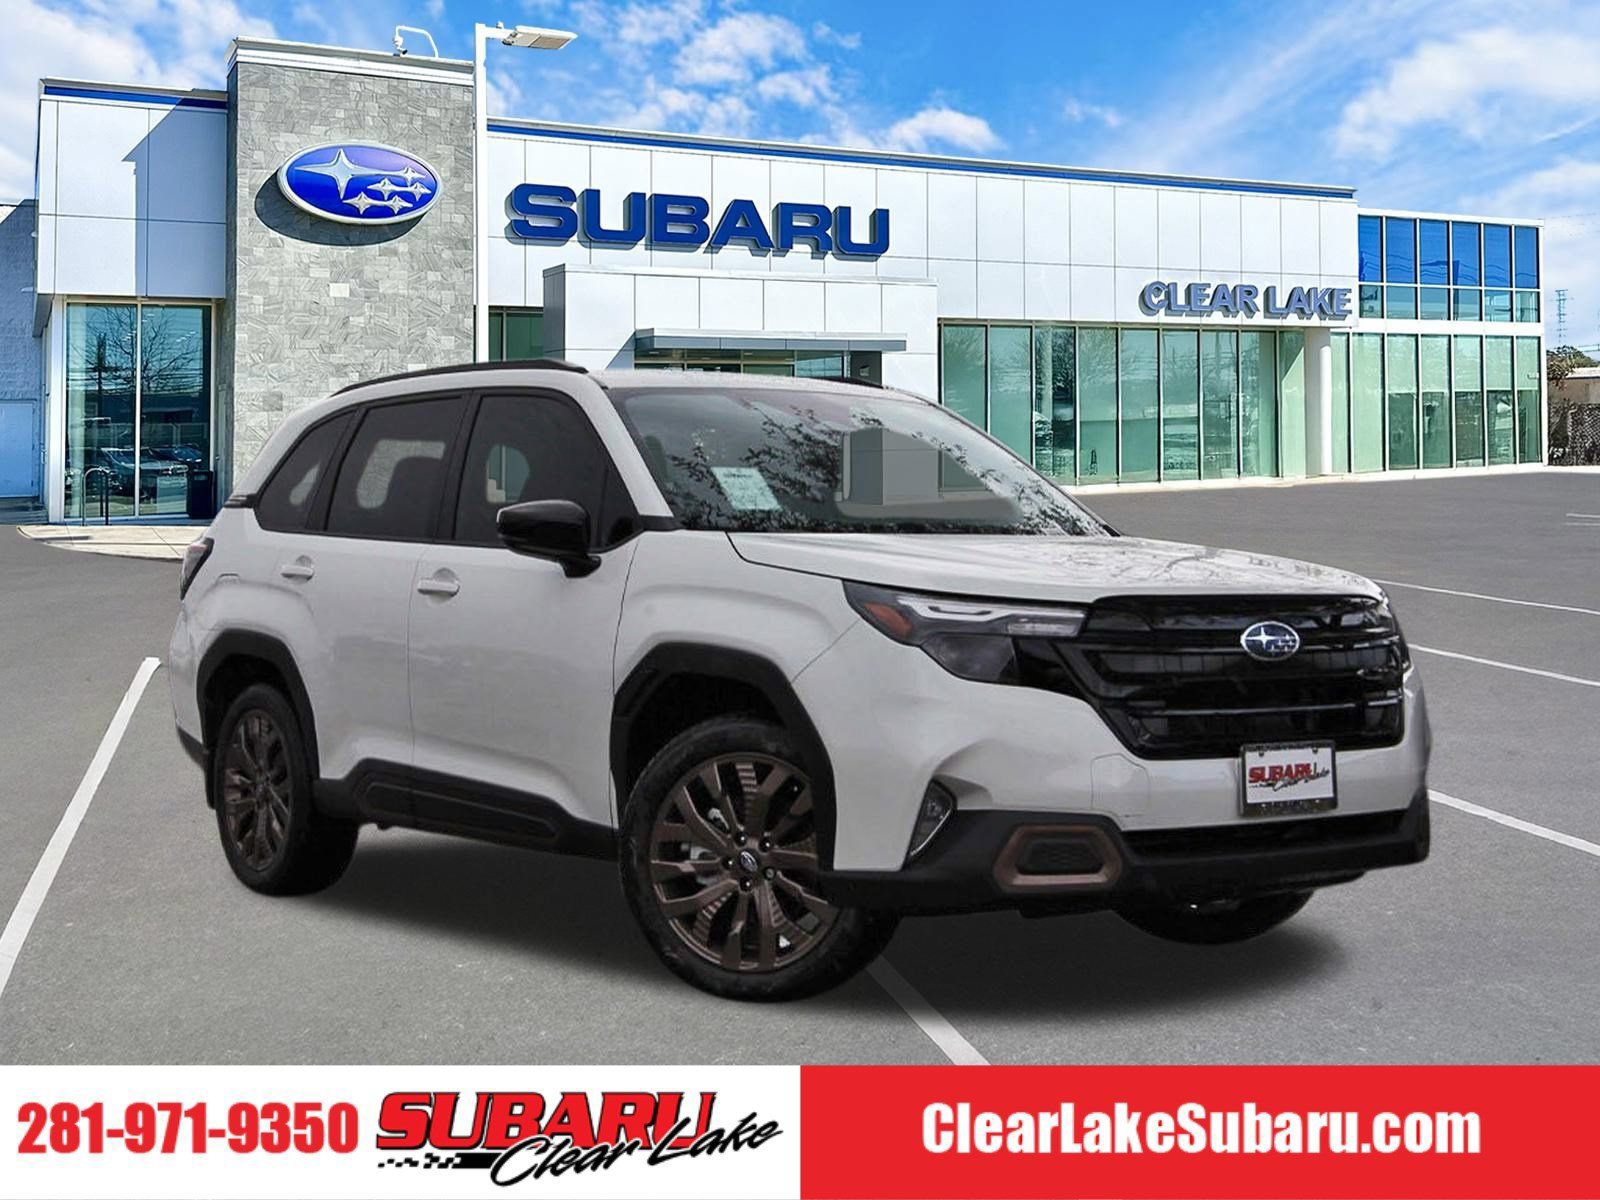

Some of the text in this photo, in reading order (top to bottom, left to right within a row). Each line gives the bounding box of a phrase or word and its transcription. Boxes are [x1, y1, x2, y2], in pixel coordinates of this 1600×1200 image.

[507, 183, 889, 257] SUBARU
[1141, 281, 1352, 319] CLEAR LAKE
